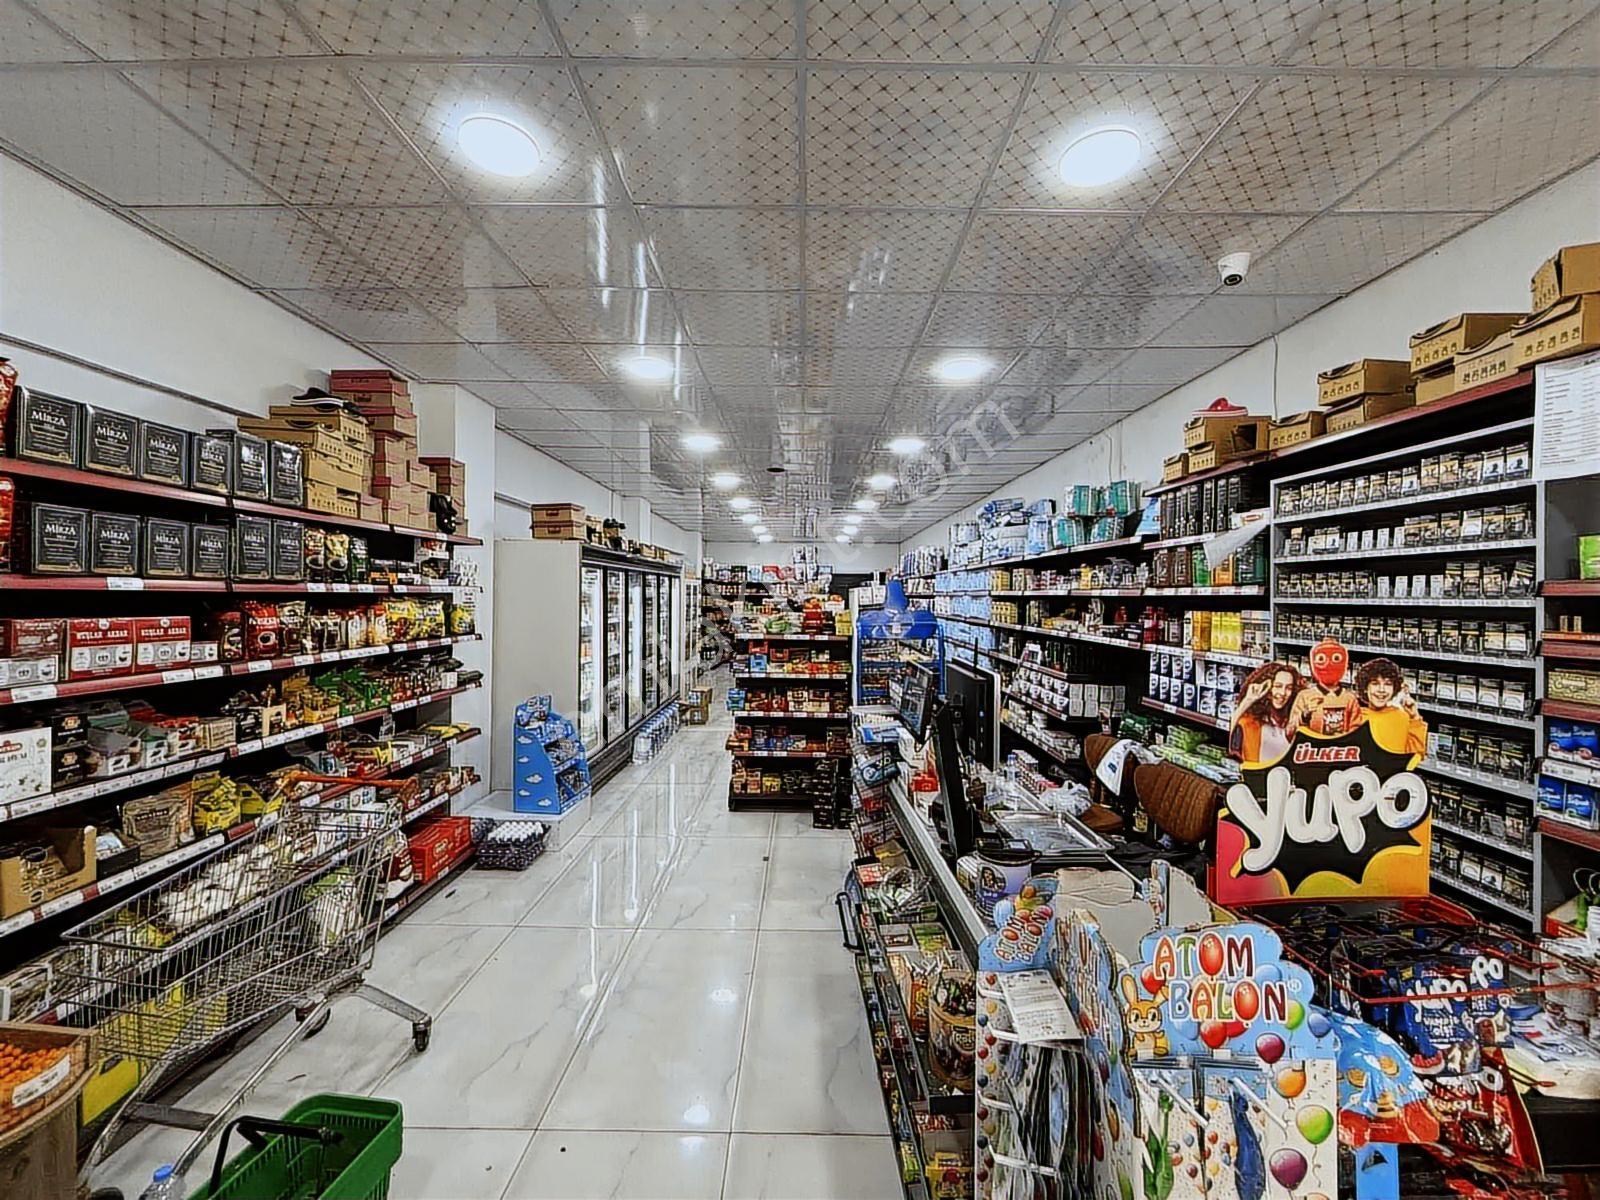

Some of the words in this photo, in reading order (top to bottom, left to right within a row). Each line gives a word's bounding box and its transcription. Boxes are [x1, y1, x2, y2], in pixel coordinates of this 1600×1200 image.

[1294, 742, 1360, 764] ÜLKER
[1153, 931, 1255, 981] ATOM
[1169, 979, 1288, 1024] BALON
